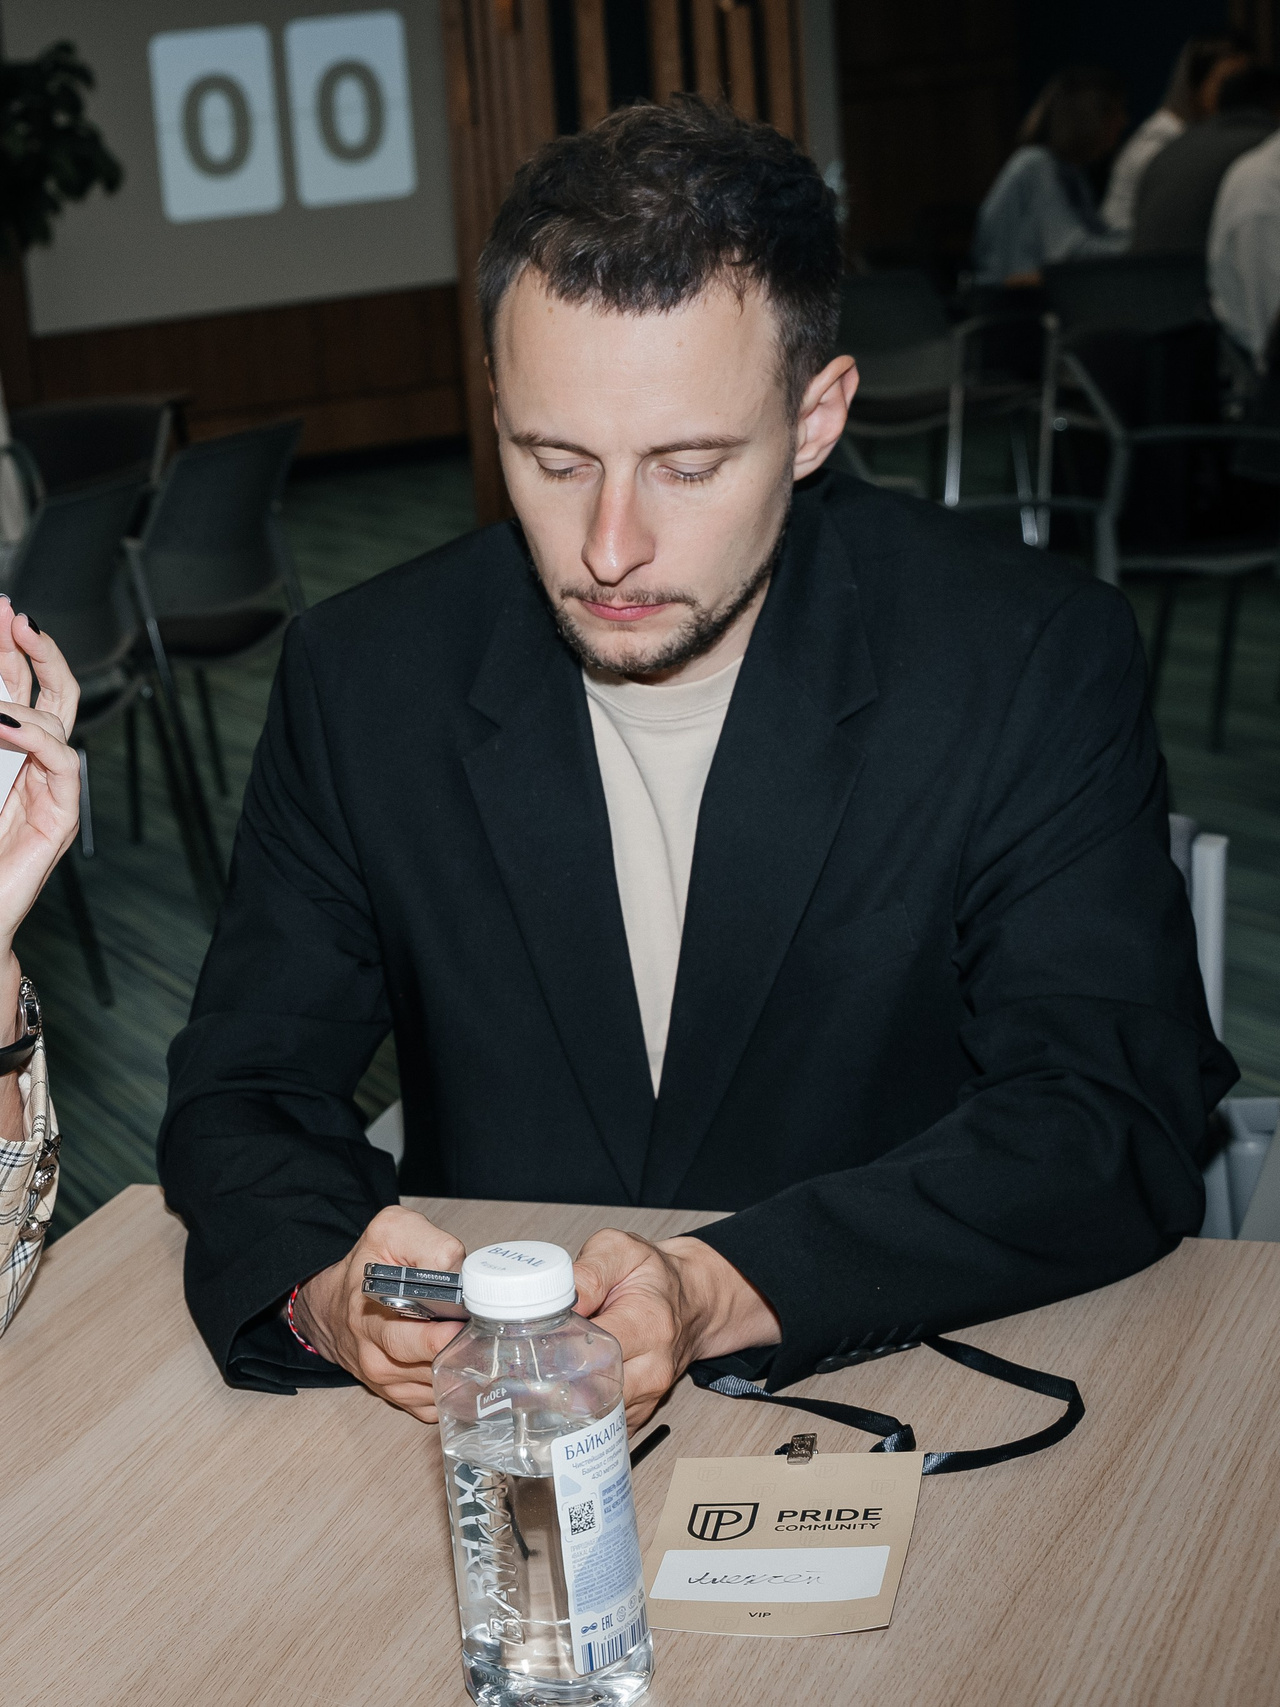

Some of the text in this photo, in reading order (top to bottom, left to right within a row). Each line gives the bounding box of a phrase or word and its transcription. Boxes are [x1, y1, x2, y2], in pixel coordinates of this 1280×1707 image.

[488, 1247, 546, 1267] BAIKAL
[776, 1508, 883, 1523] PRIDE
[774, 1523, 880, 1532] COMMUNITY
